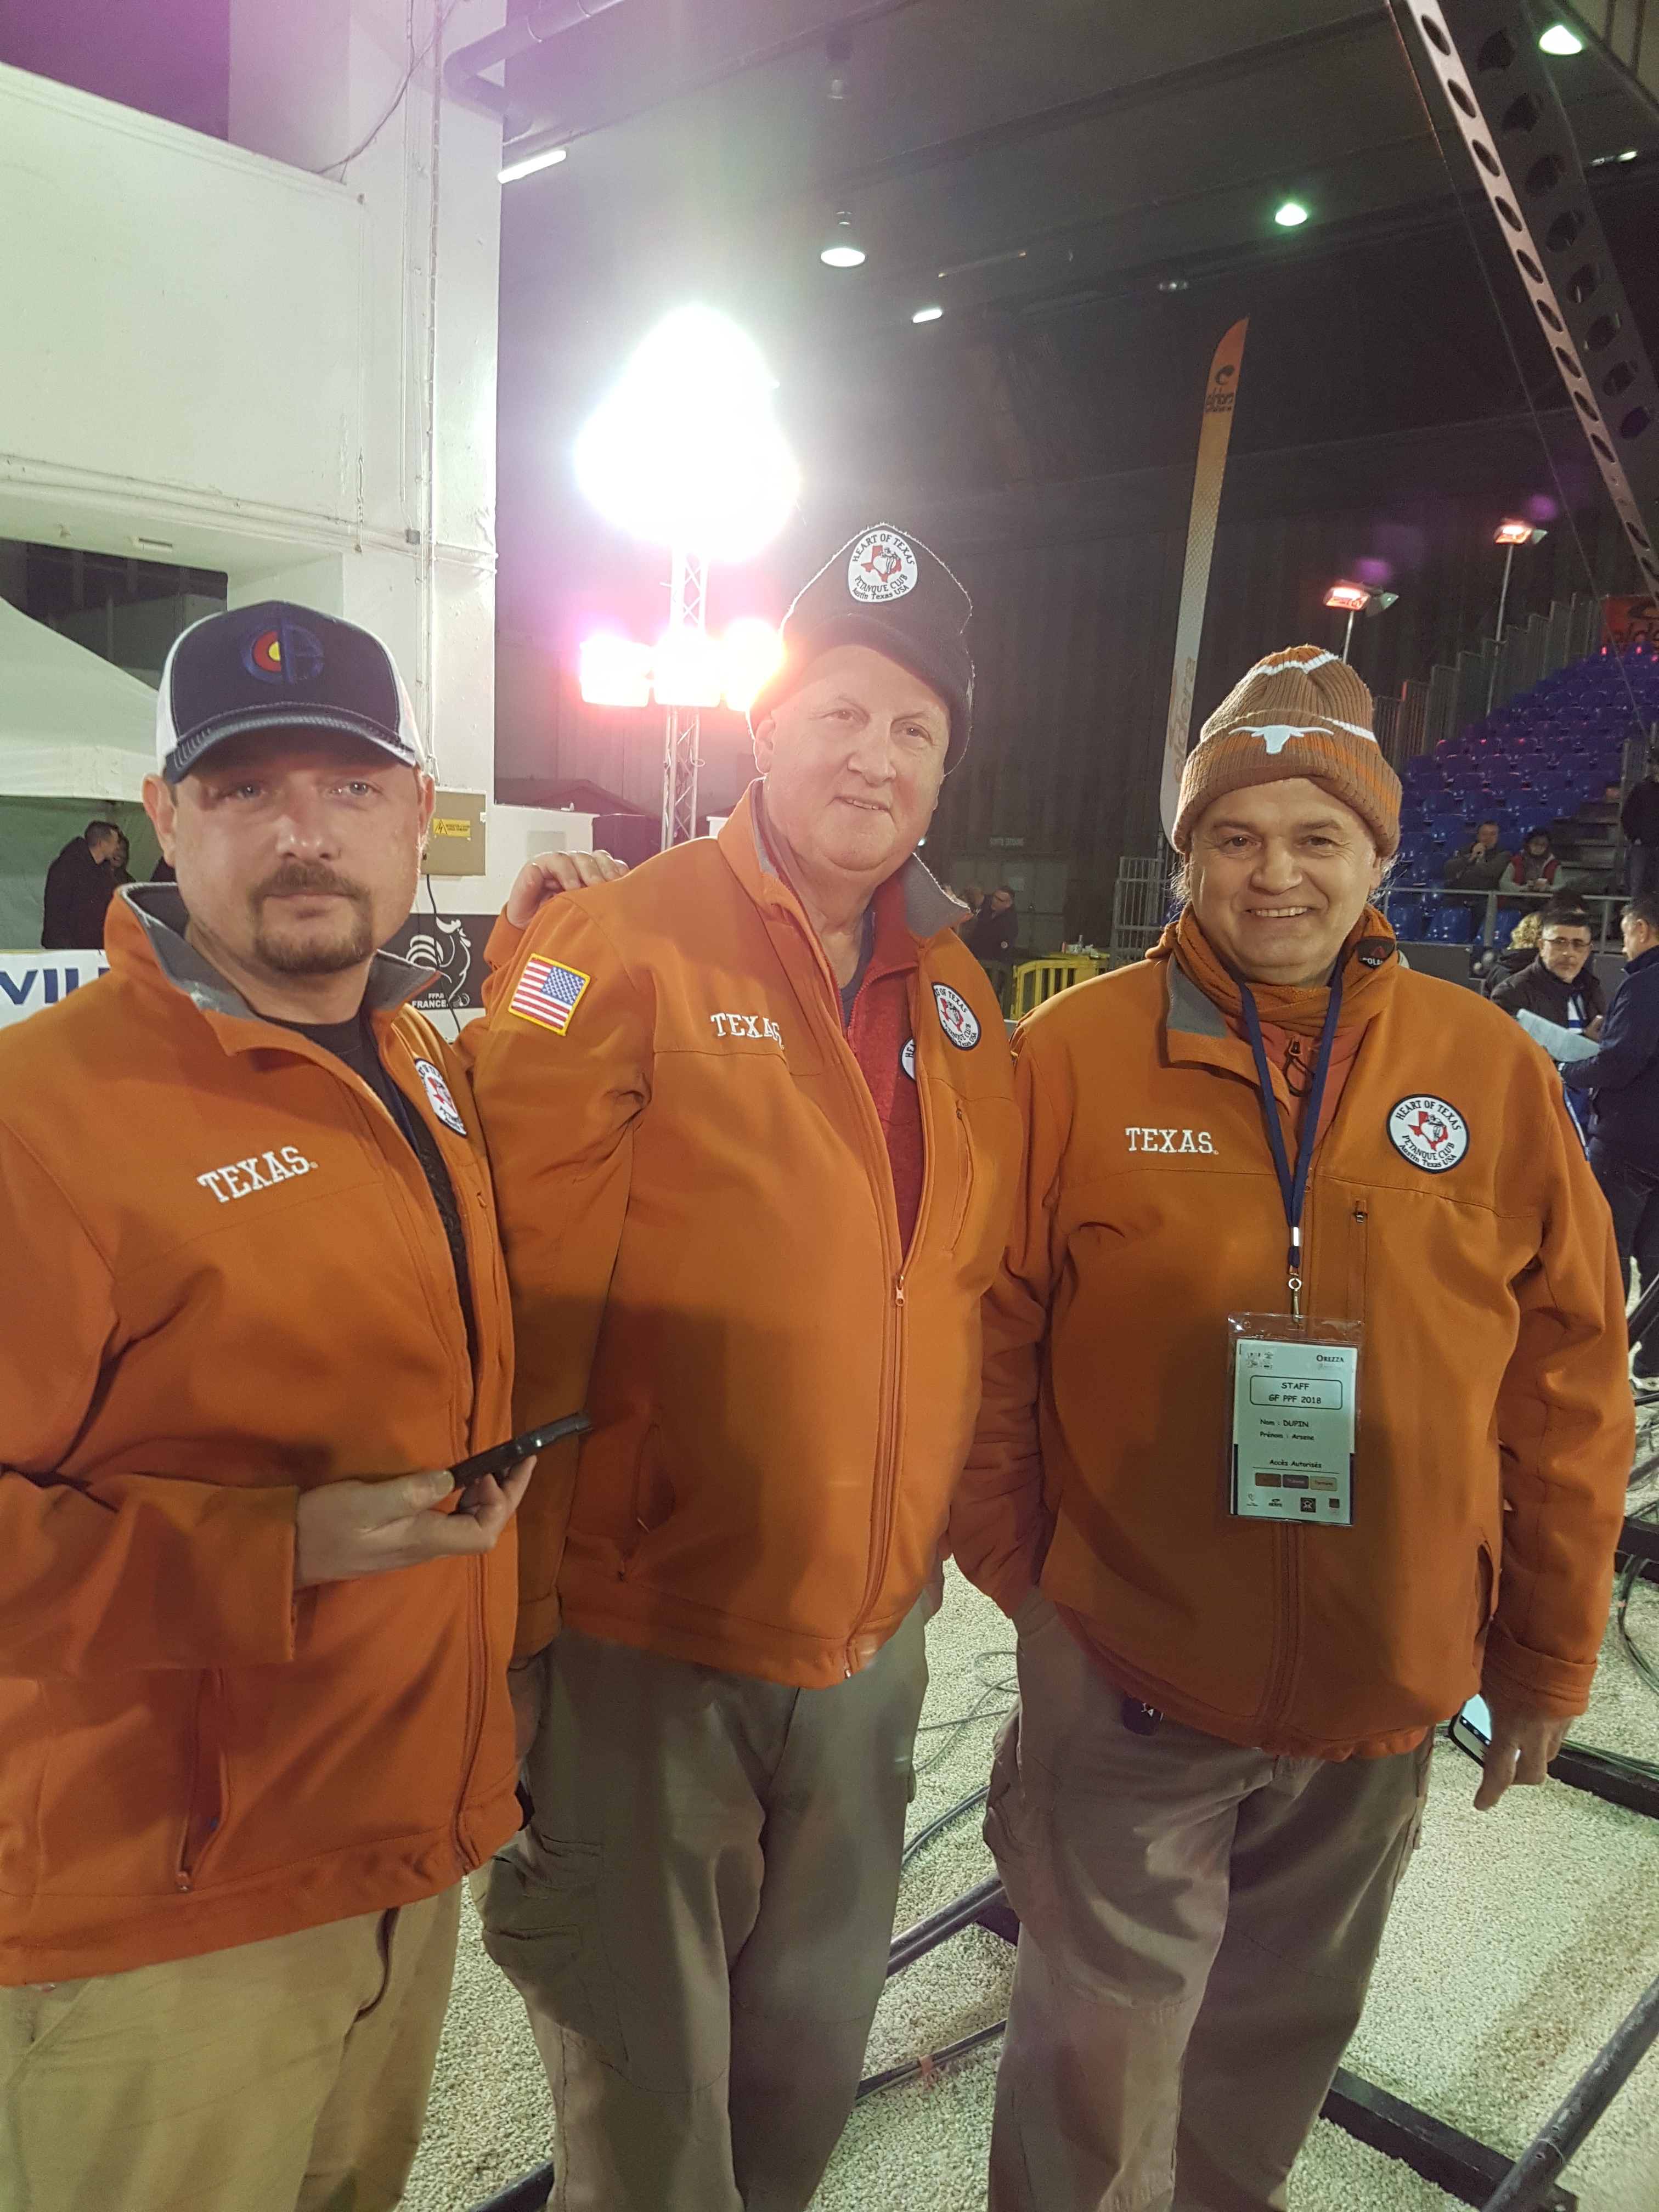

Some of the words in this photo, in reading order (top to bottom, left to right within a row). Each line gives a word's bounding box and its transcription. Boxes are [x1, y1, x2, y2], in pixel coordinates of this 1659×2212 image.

[852, 535, 877, 562] HEART
[880, 534, 892, 542] OF
[893, 538, 915, 565] TEXAS
[852, 588, 868, 600] Austin
[894, 585, 909, 595] USA
[855, 575, 888, 592] PETANQUE
[890, 574, 907, 589] CLUB
[411, 1000, 447, 1009] FRANCE
[939, 988, 946, 996] OF
[948, 991, 968, 1013] TEXAS
[710, 1013, 782, 1049] TEXAS
[1396, 1100, 1421, 1120] HEART
[1424, 1100, 1436, 1109] OF
[1437, 1104, 1462, 1130] TEXAS
[1125, 1127, 1214, 1154] TEXAS
[1402, 1135, 1437, 1160] PETANQUE
[1438, 1142, 1454, 1159] CLUB
[1400, 1144, 1420, 1163] Austin
[1422, 1159, 1442, 1167] Texas
[1442, 1154, 1457, 1165] USA
[196, 1146, 310, 1203] TEXAS
